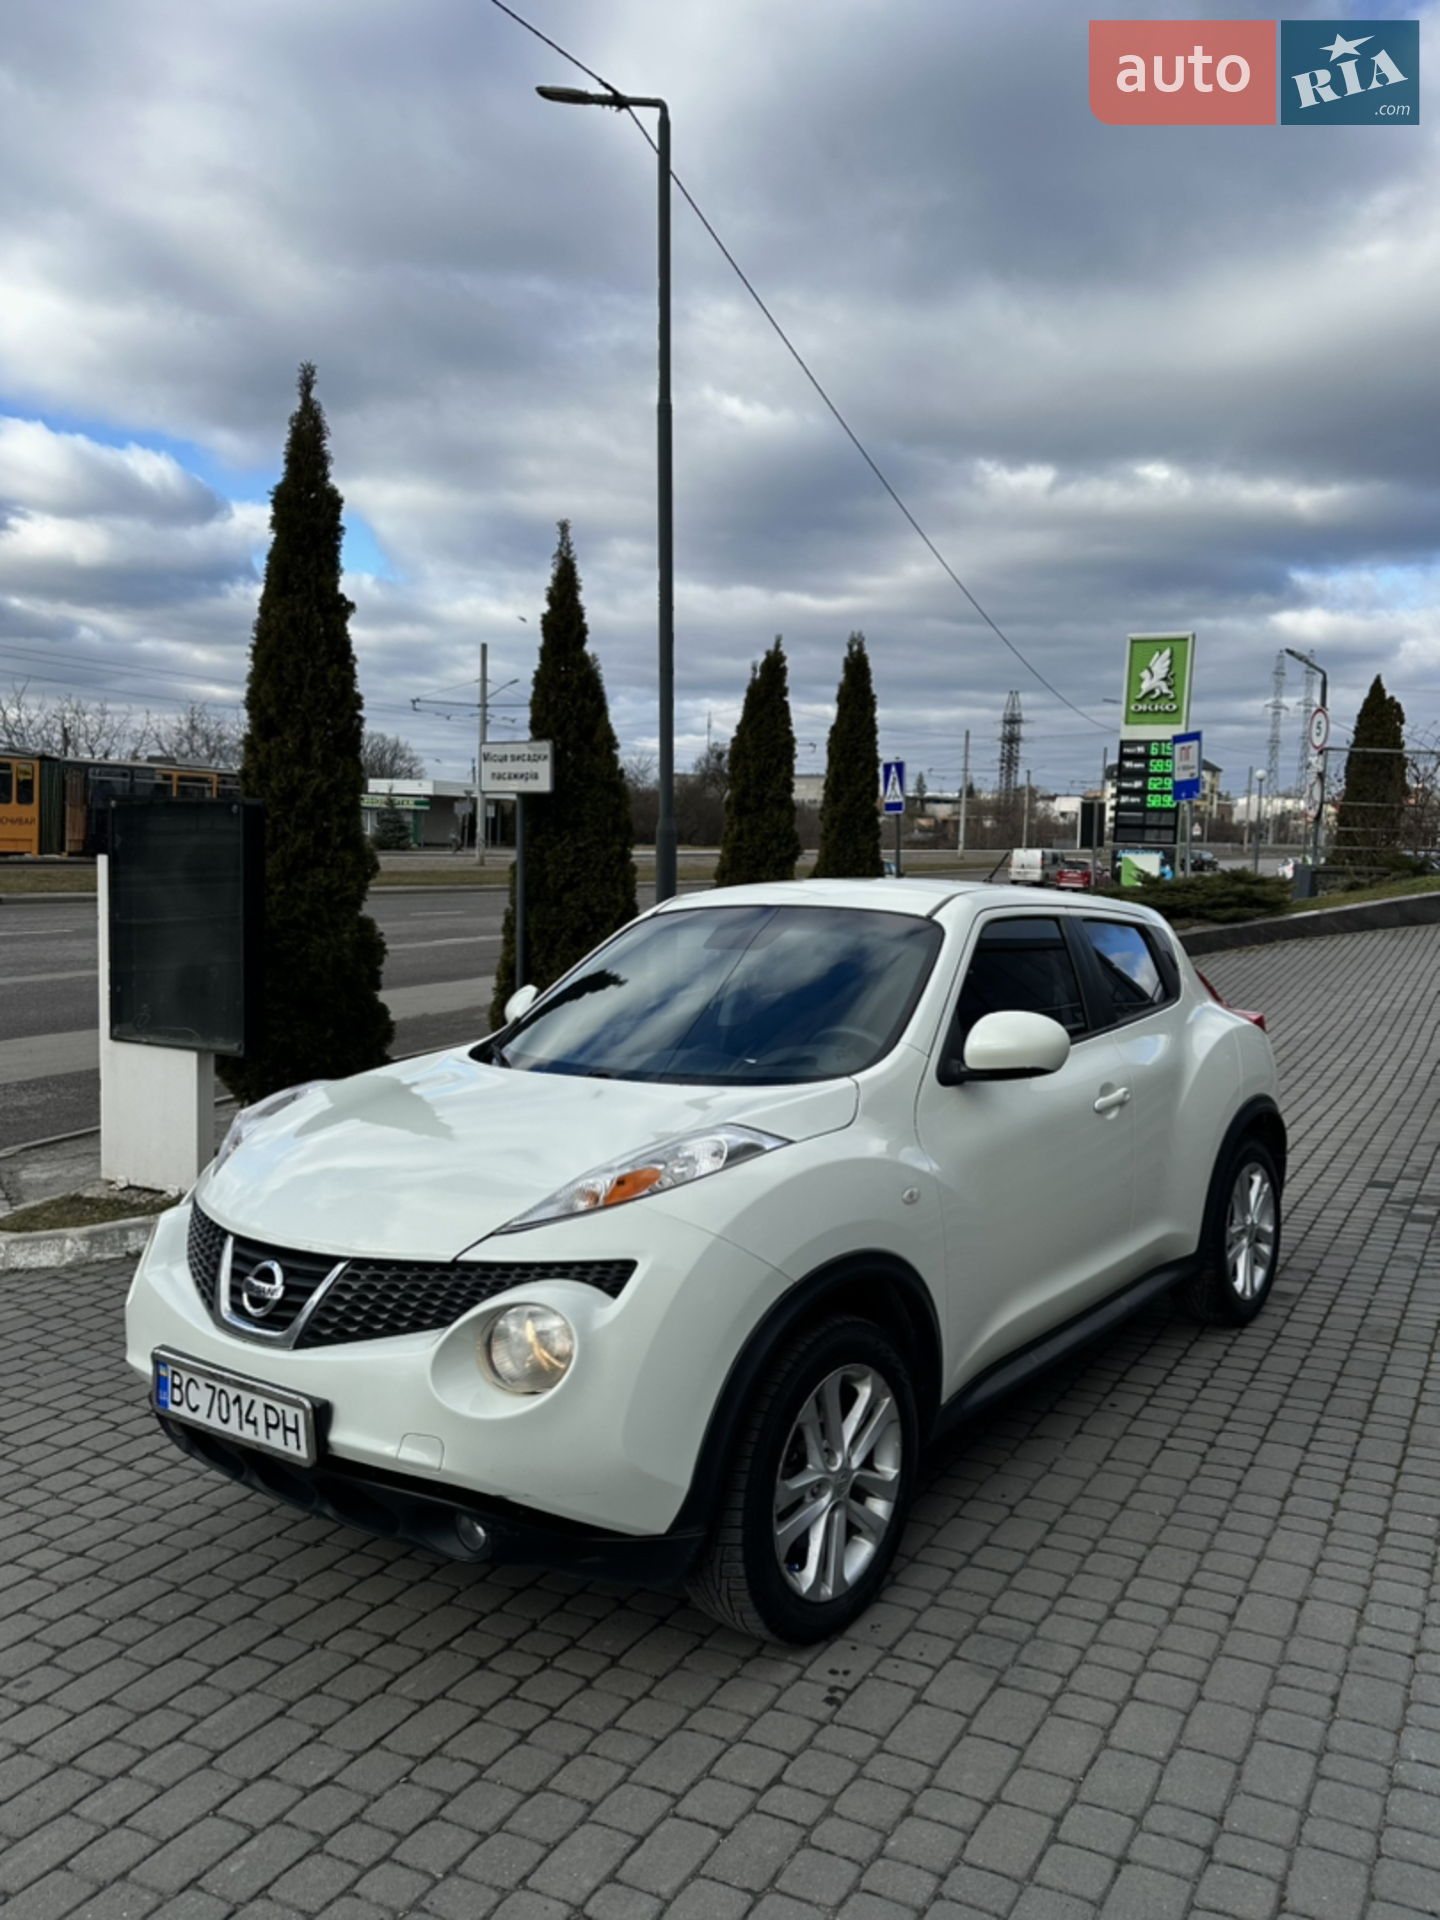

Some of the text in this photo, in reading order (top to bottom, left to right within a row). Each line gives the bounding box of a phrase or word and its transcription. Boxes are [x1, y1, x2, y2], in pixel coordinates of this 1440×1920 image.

[1316, 721, 1322, 737] 5
[483, 752, 549, 764] Місце висадки
[491, 769, 540, 783] пасажирів
[204, 1382, 259, 1437] 7014
